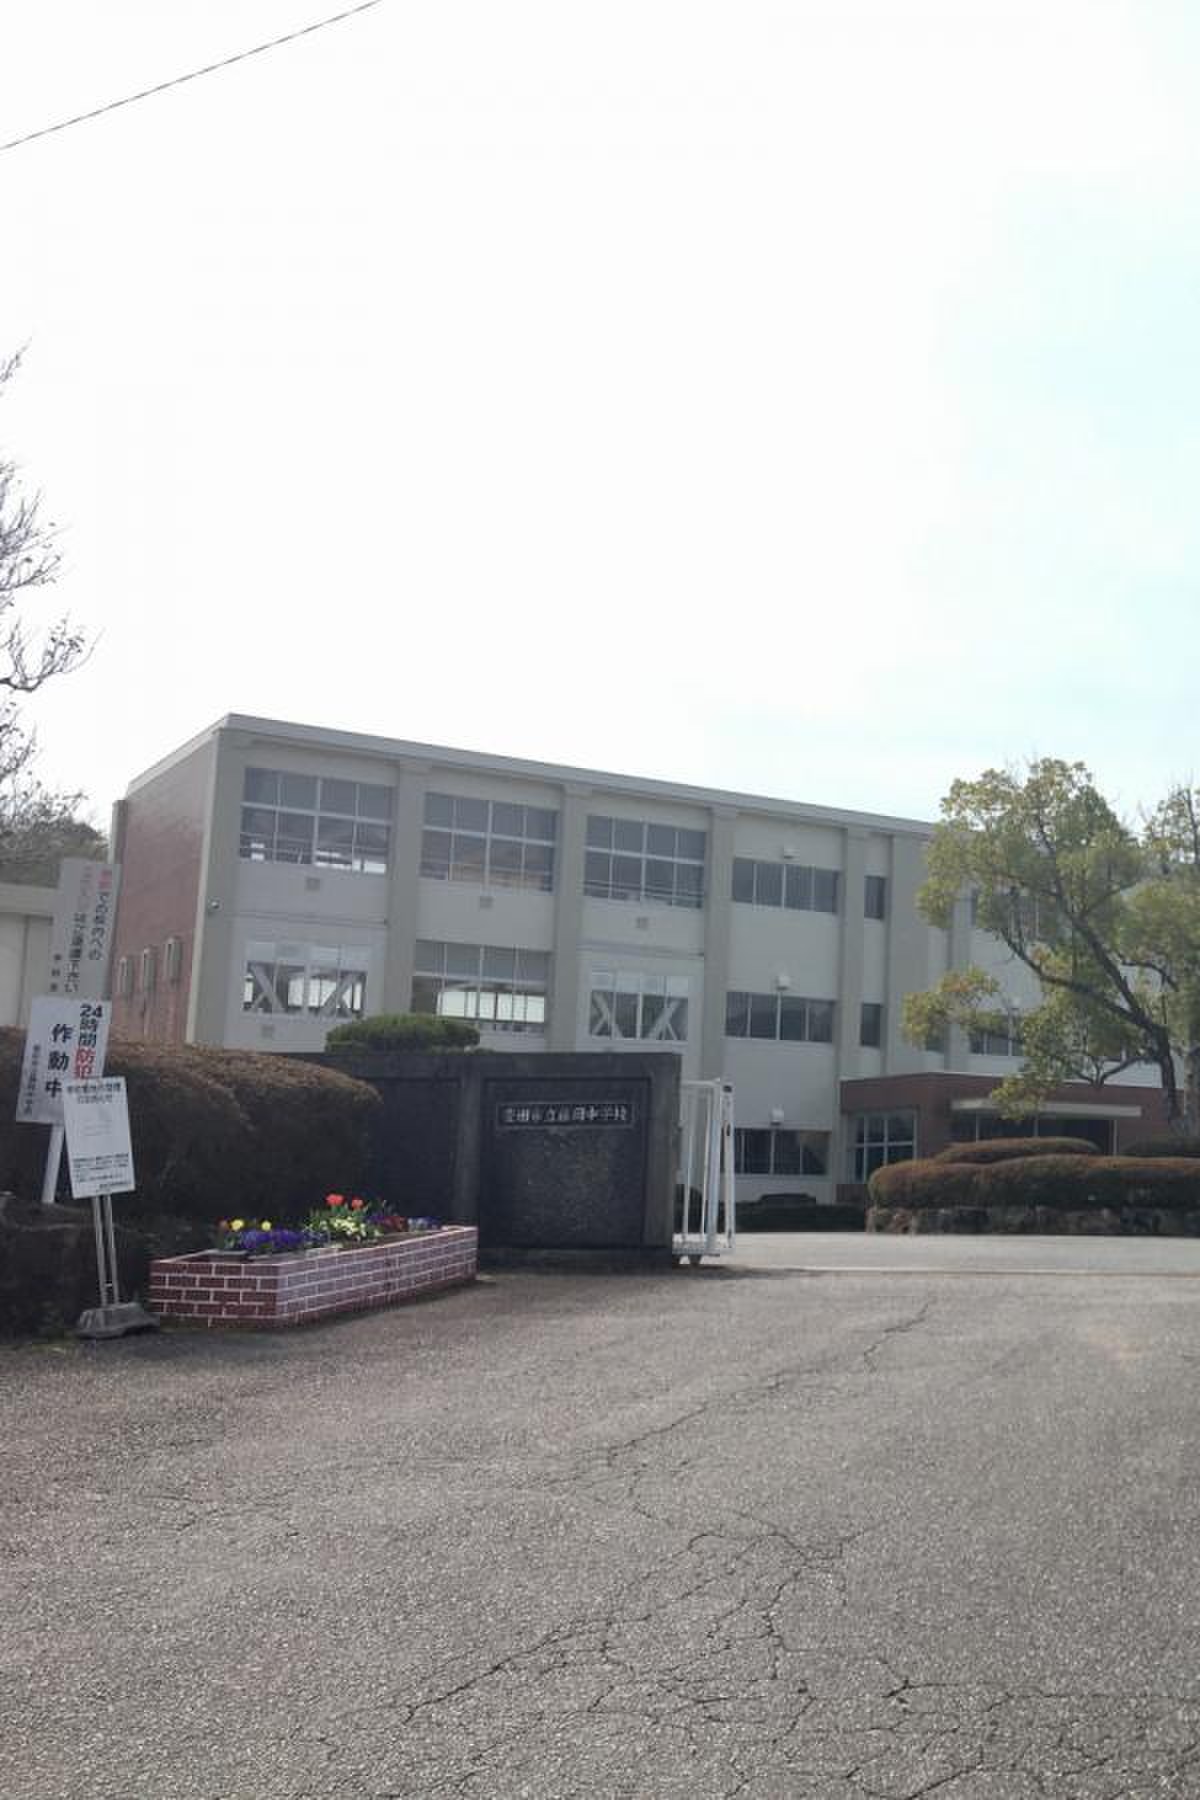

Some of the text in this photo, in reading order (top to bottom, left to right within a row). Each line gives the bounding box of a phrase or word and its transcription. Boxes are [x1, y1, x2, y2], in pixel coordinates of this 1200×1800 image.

[46, 1023, 75, 1098] 作動中
[75, 1003, 103, 1080] 24時間防犯
